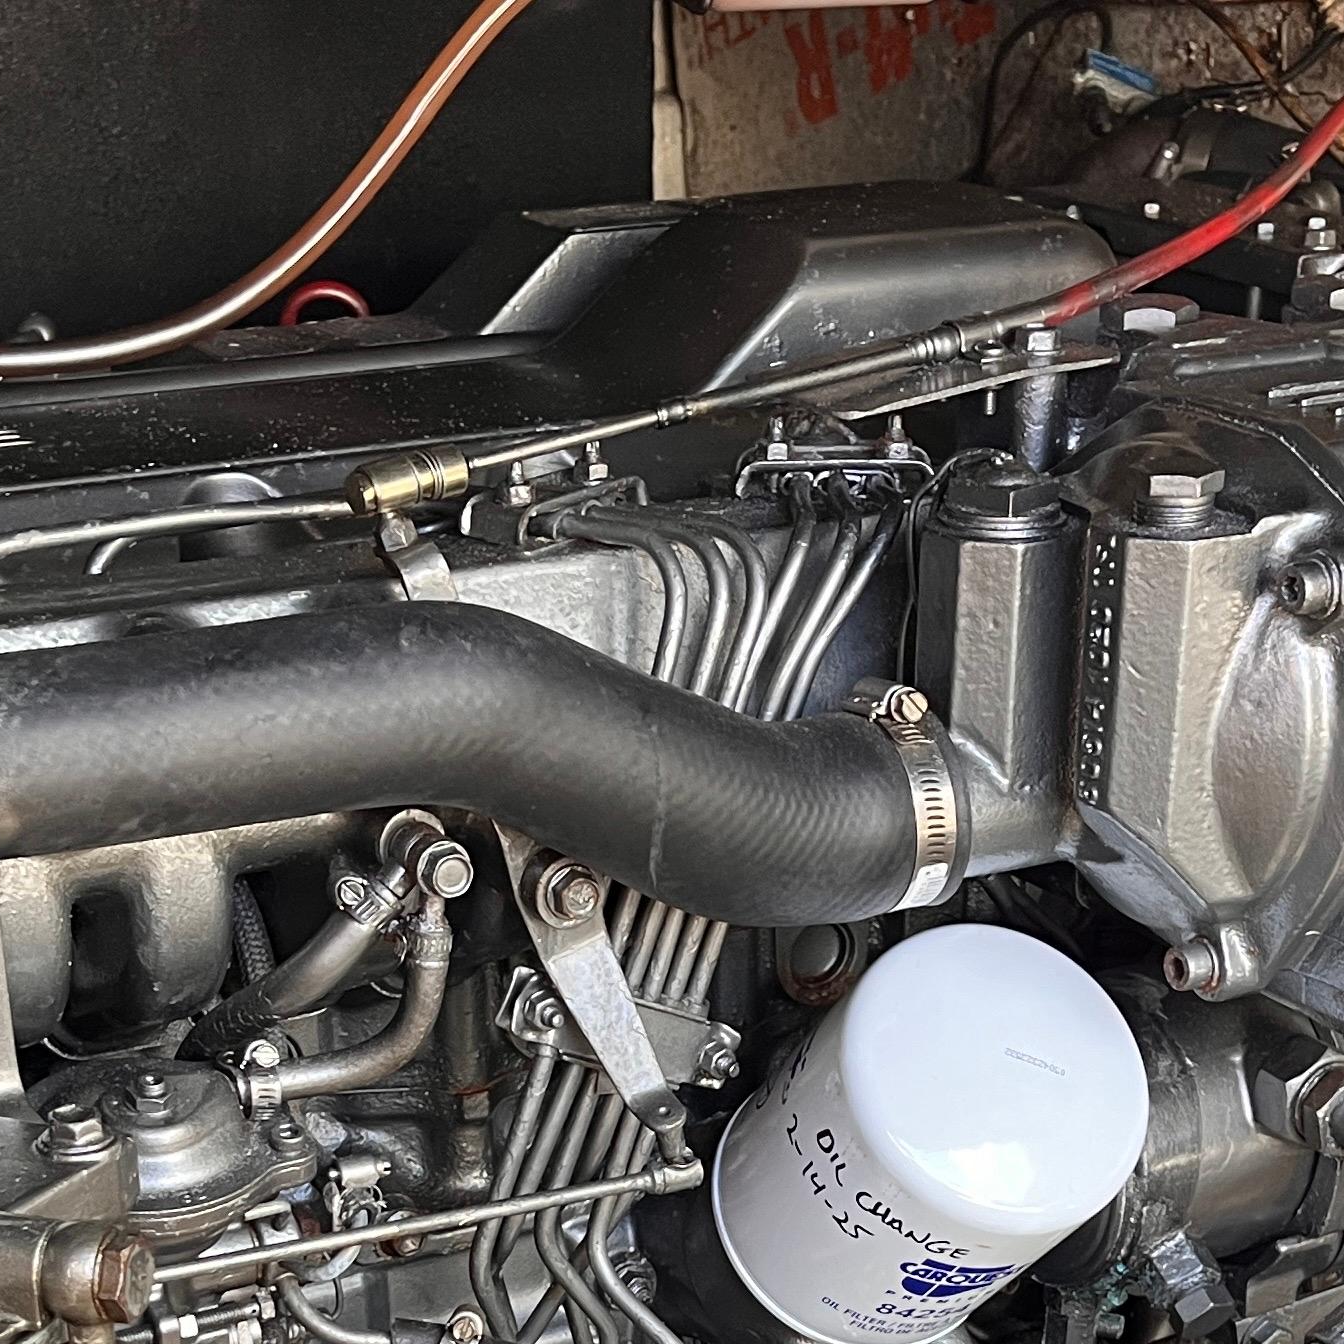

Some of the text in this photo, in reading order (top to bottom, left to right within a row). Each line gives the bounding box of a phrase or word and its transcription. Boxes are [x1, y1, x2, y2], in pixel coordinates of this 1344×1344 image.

[786, 1113, 875, 1239] 2-14-25
[816, 1128, 968, 1261] OIL CHANGE
[821, 1295, 840, 1311] OIL
[843, 1307, 887, 1326] FILTER
